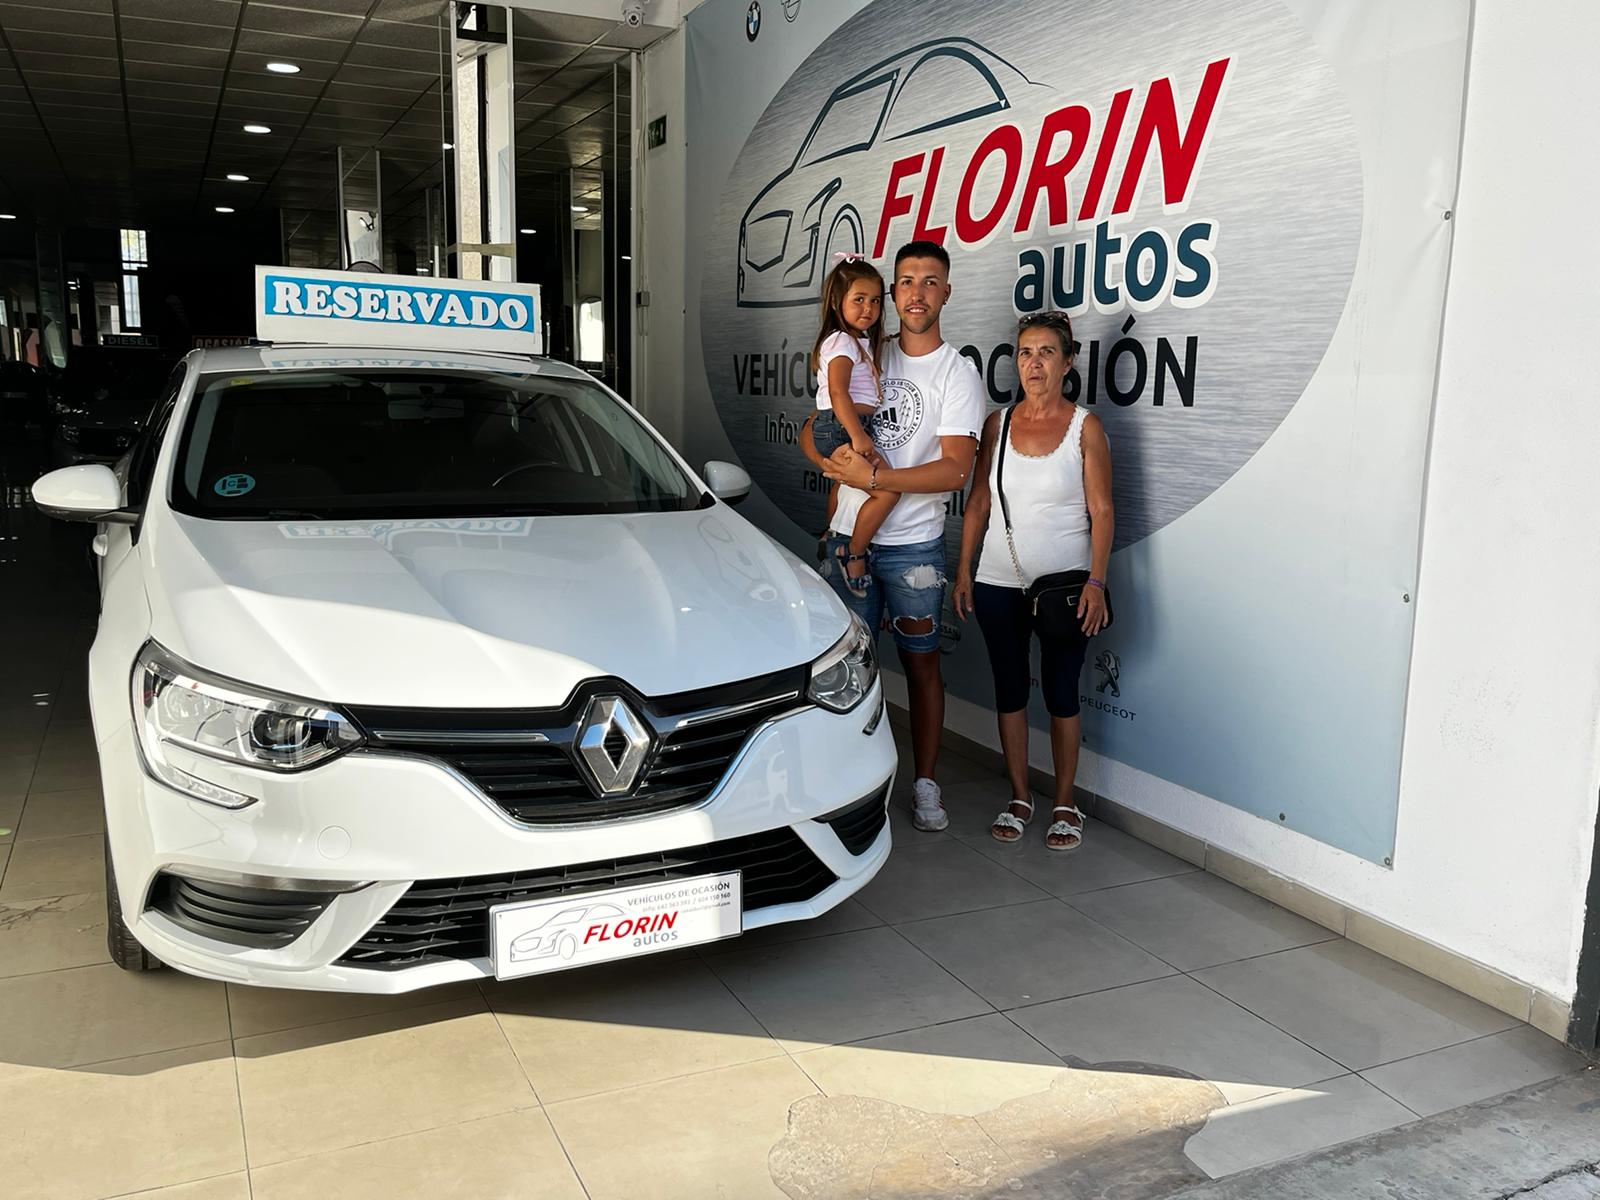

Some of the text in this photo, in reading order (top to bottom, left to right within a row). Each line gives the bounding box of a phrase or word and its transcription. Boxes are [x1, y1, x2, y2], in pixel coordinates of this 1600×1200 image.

[872, 57, 1230, 260] FLORIN
[1014, 220, 1213, 313] autos
[273, 281, 528, 328] RESERVADO
[108, 336, 152, 346] DIESEL
[765, 414, 799, 445] Info:
[1080, 696, 1136, 721] PEUGEOT
[628, 882, 730, 906] VEHÍCULOS DE OCASIÓN
[583, 911, 679, 945] FLORIN
[633, 930, 679, 948] autos
